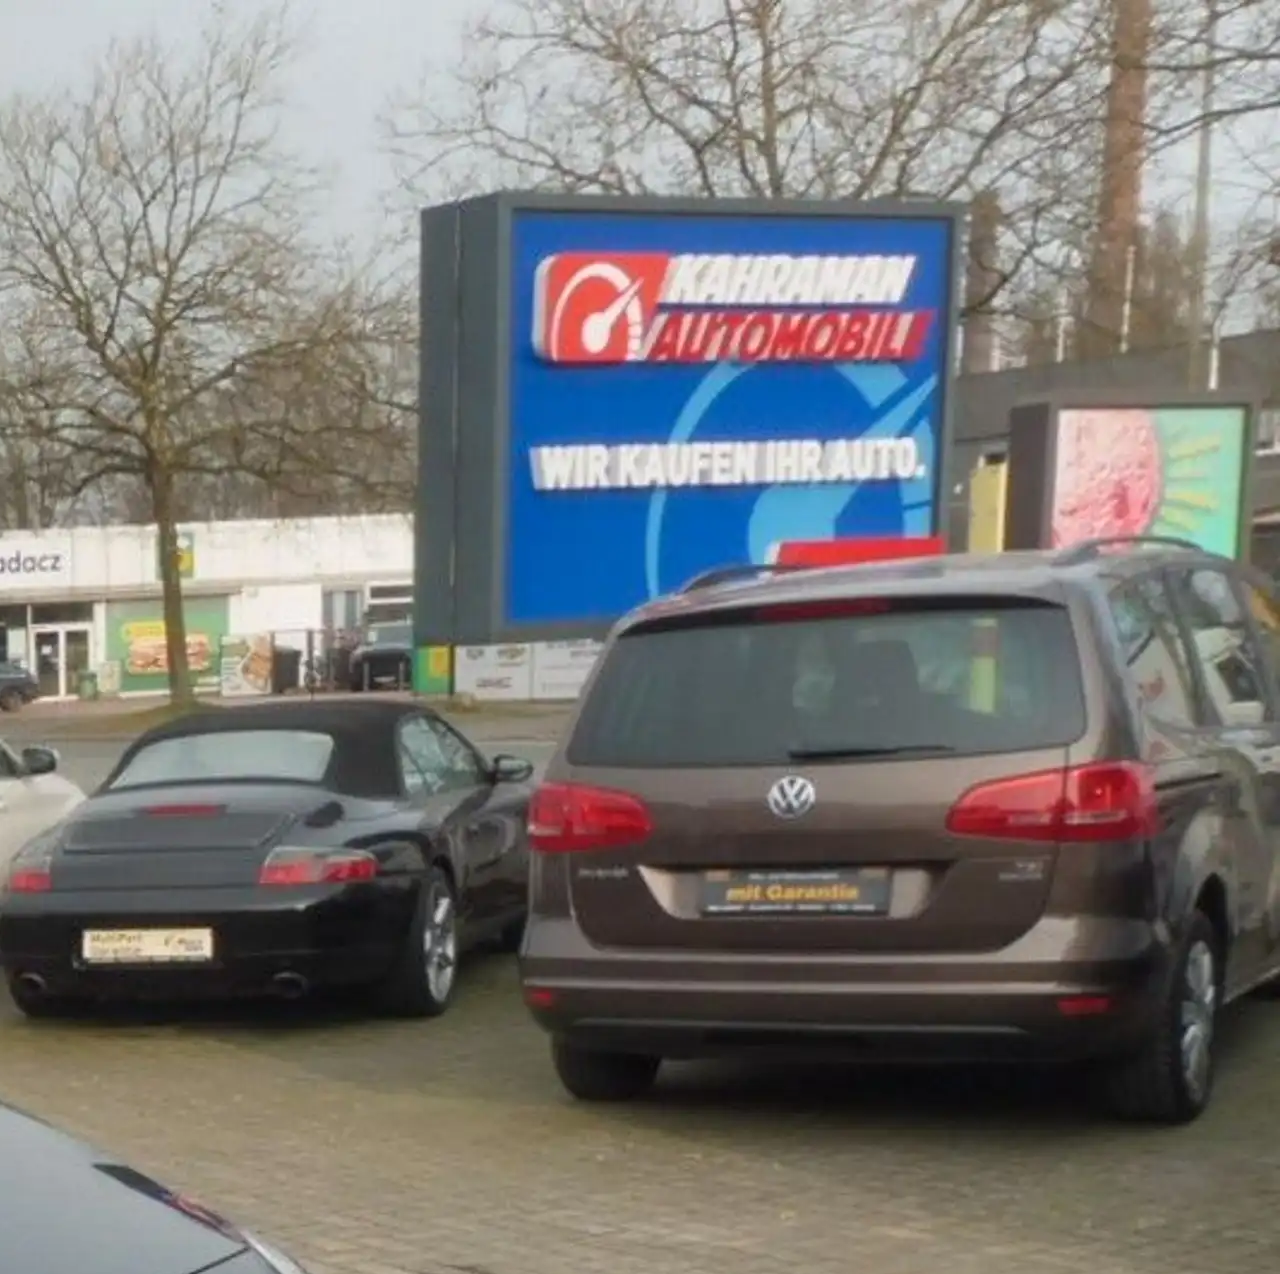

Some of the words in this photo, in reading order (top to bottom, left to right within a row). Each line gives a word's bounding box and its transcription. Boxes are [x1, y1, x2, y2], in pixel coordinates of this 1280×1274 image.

[665, 253, 917, 304] KAHRAMAN
[529, 444, 612, 491] WIR
[617, 440, 761, 486] KAUFEN
[763, 439, 826, 482] IHR
[828, 436, 927, 480] AUTO.
[726, 884, 761, 901] mit
[765, 882, 860, 901] Garantie
